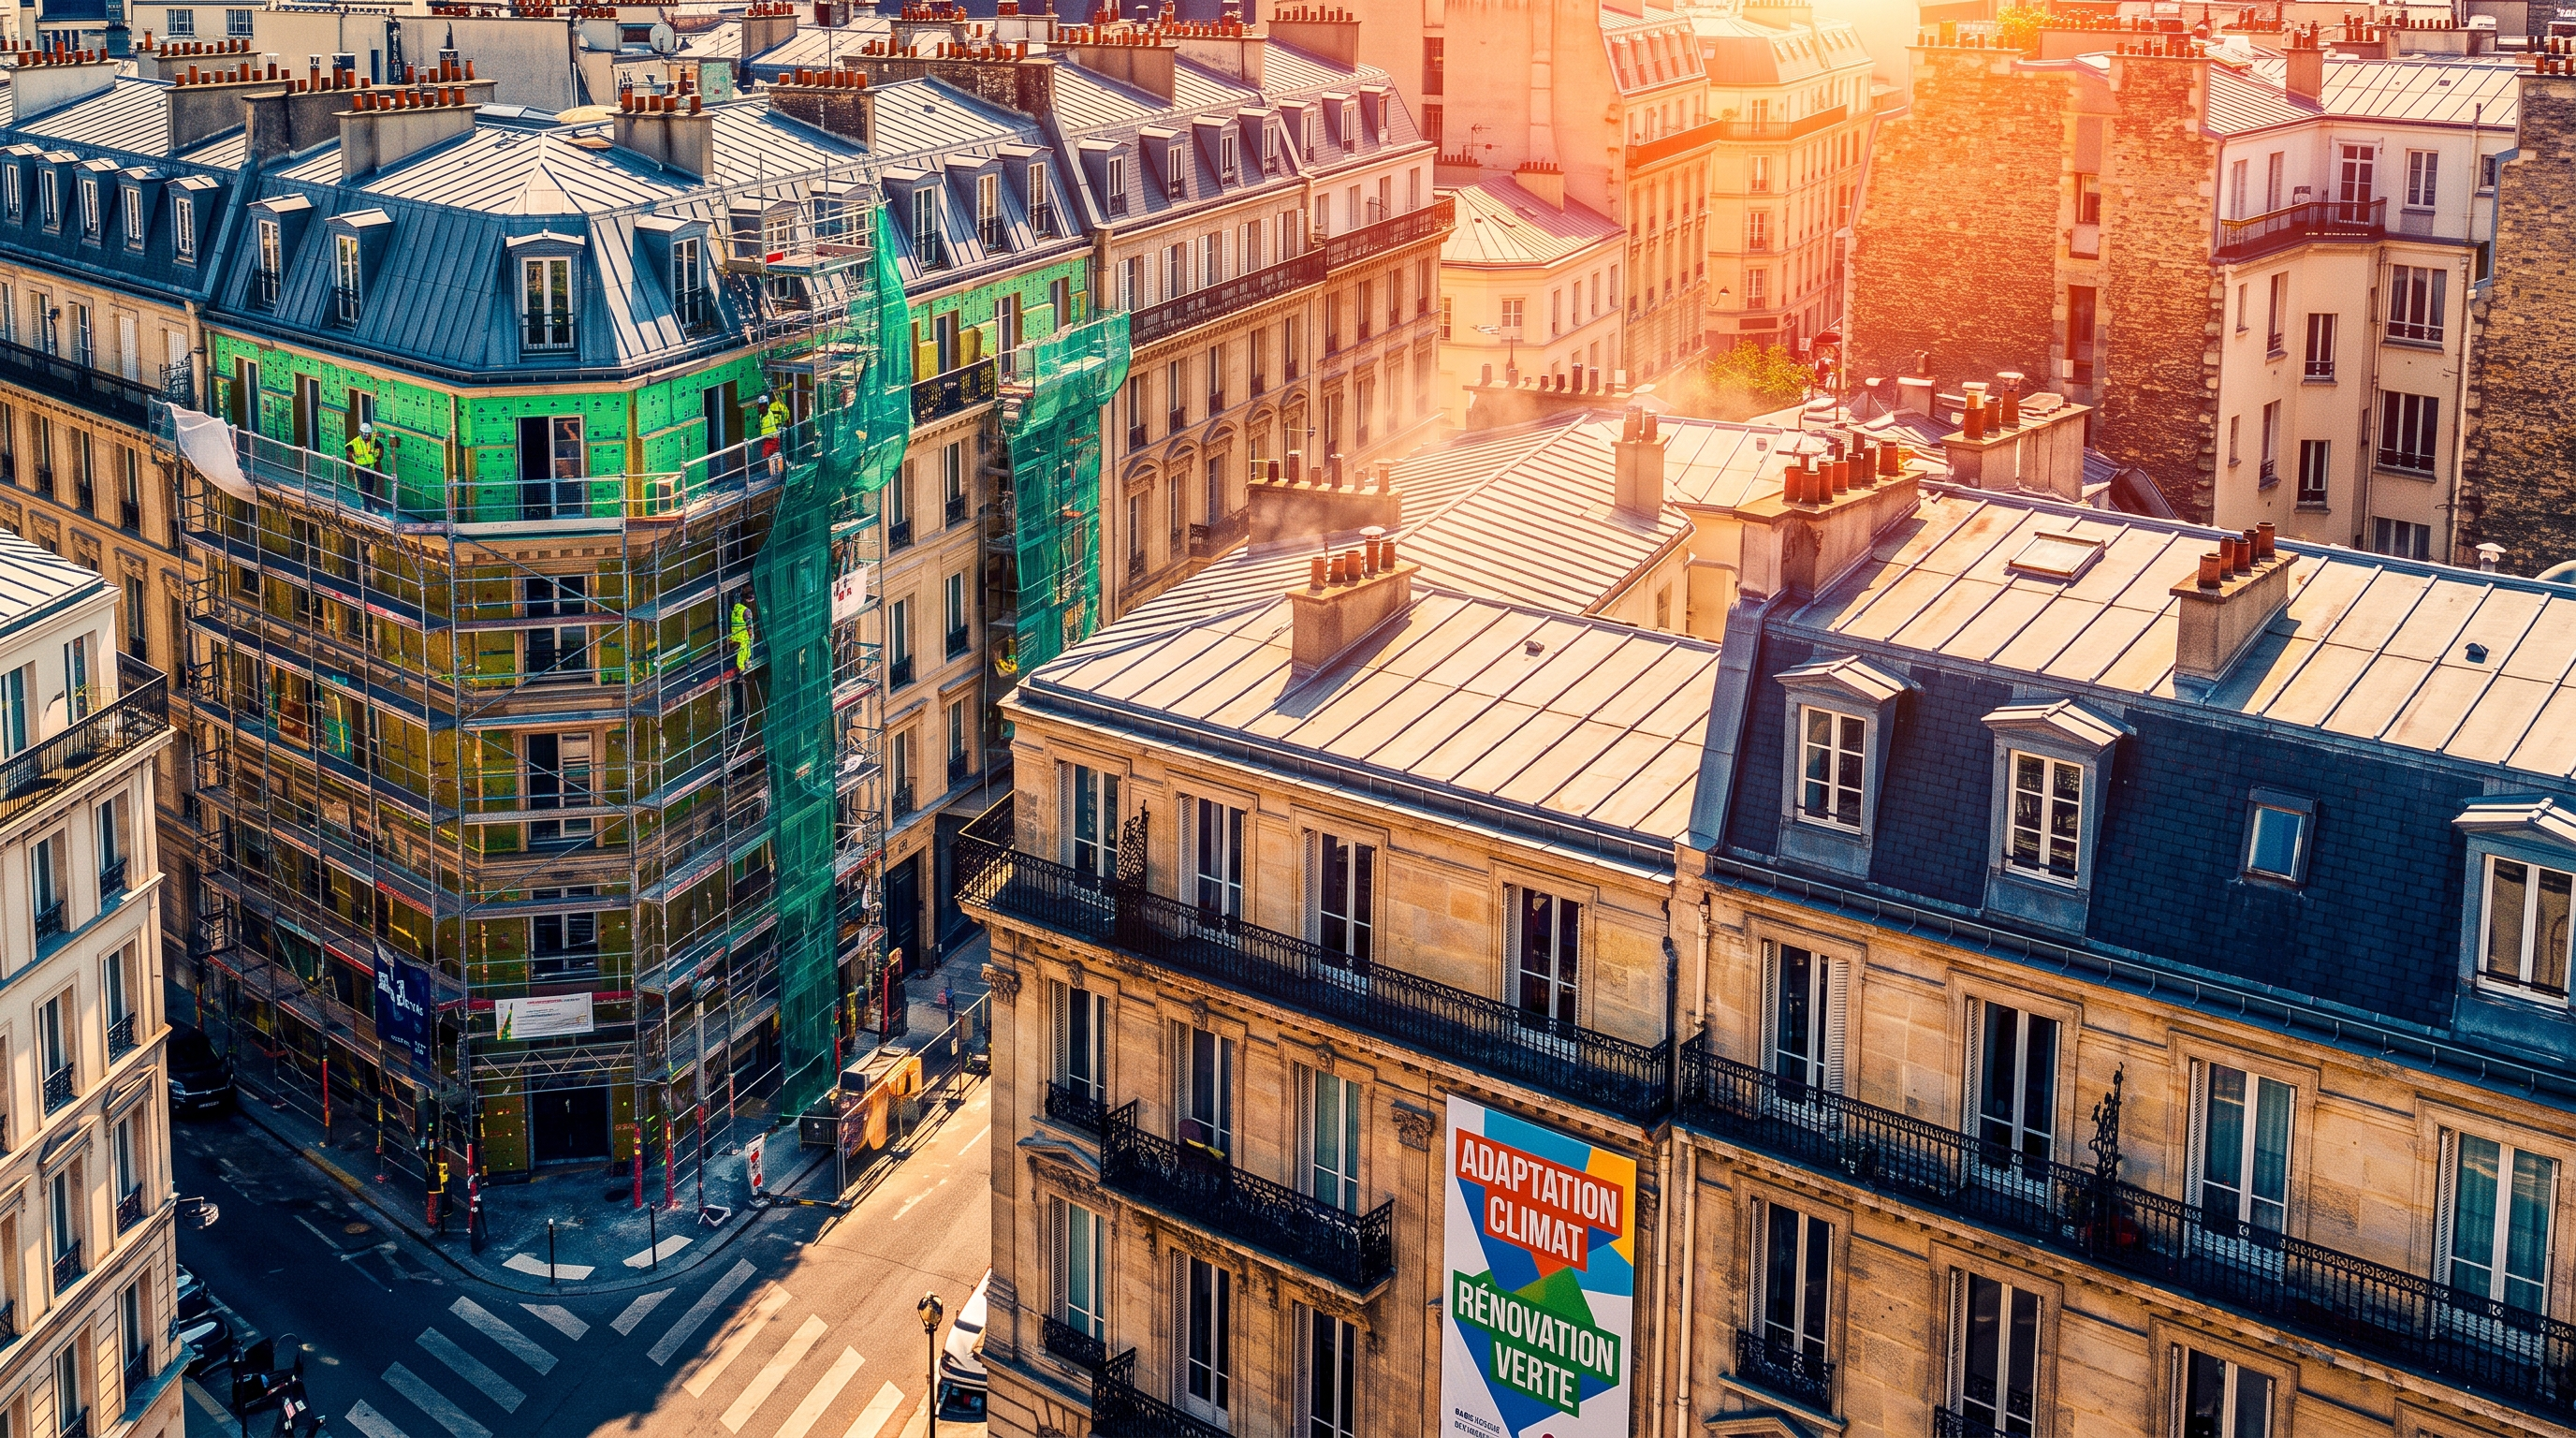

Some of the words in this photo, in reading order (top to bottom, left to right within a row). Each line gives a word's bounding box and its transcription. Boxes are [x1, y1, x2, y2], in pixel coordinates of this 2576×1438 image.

[1460, 1138, 1617, 1228] ADAPTATION
[1489, 1196, 1584, 1263] CLIMAT
[1457, 1280, 1614, 1377] RÉNOVATION
[1495, 1341, 1575, 1409] VERTE
